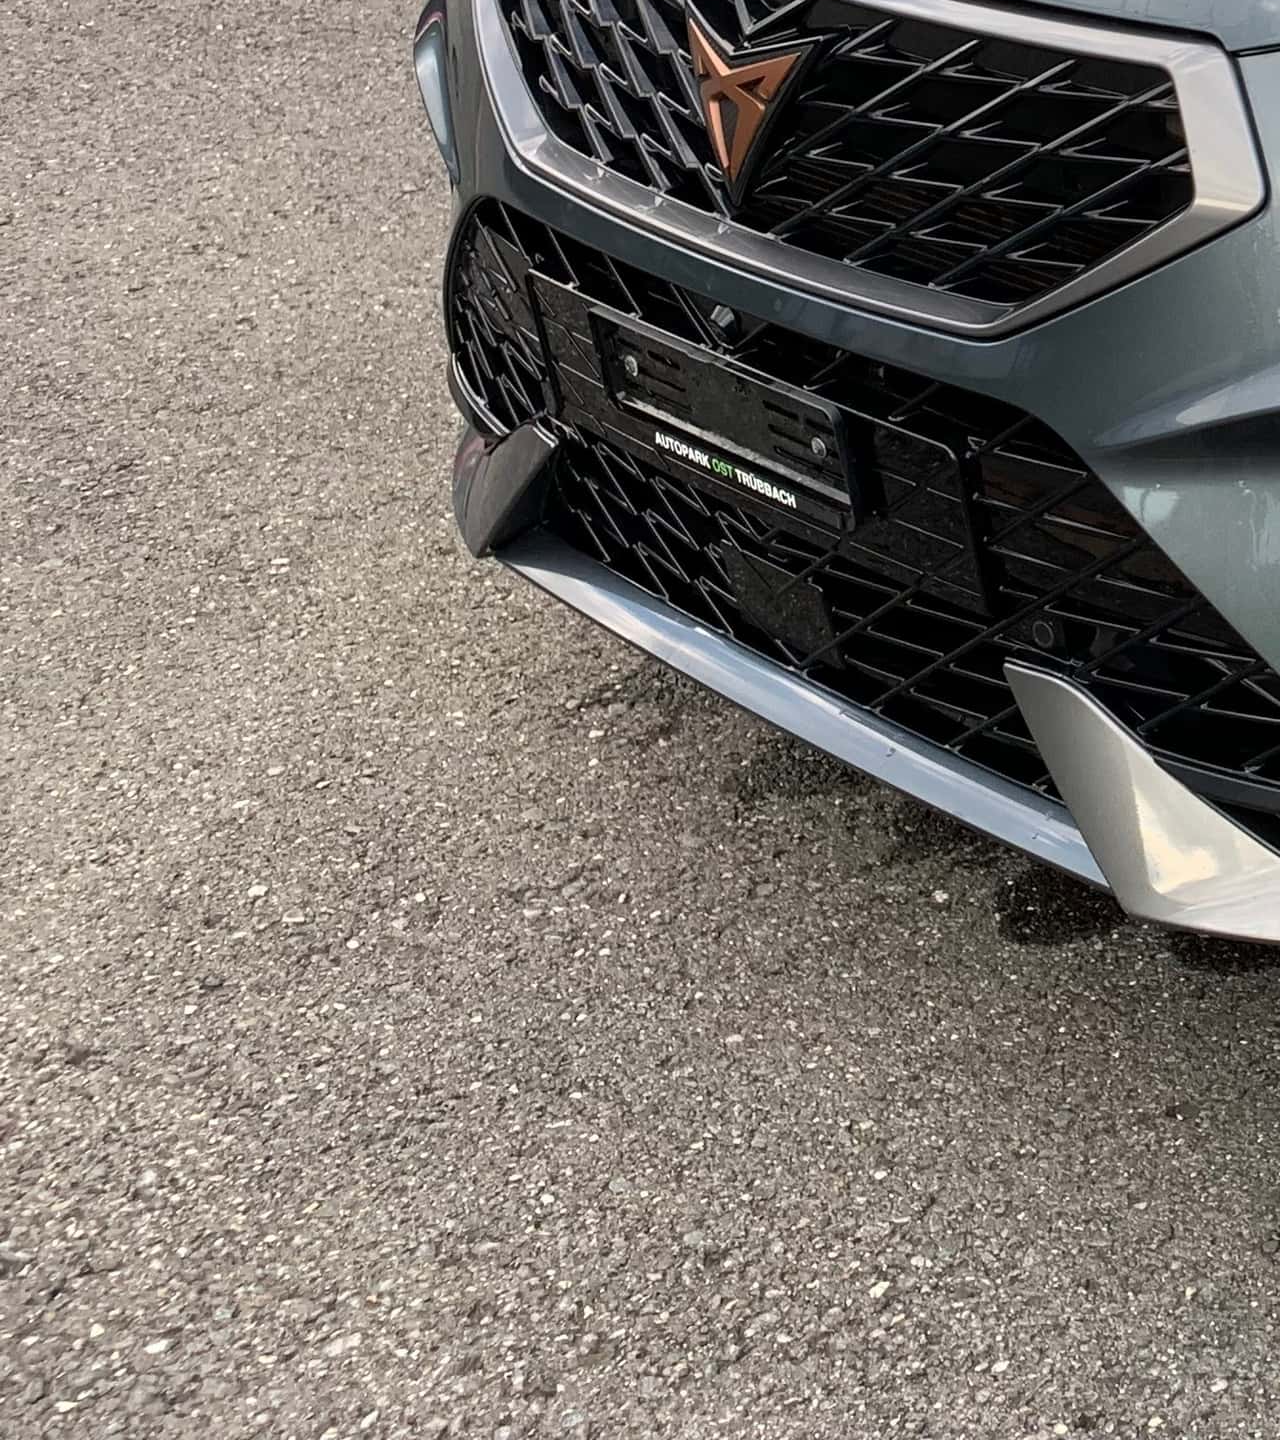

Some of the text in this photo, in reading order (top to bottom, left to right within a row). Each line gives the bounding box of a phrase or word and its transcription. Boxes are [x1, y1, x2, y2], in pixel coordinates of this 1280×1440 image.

[655, 431, 797, 509] AUTOPARK OST TRÜBBACH
